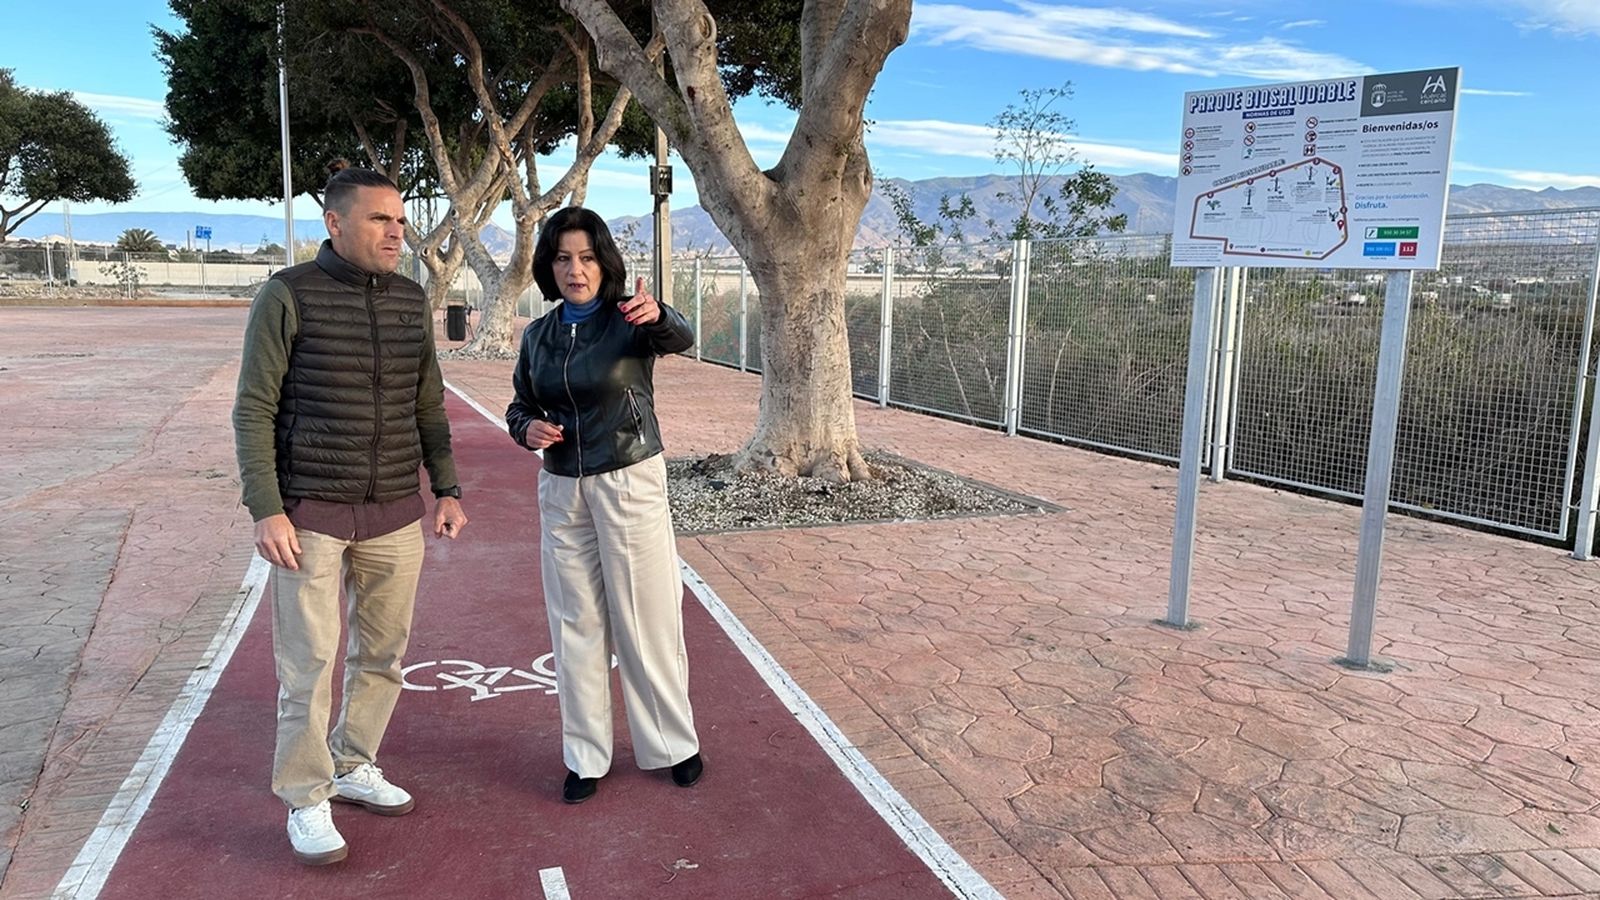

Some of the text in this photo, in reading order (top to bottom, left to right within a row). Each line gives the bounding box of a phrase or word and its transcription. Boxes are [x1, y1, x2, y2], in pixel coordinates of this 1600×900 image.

[1190, 81, 1356, 114] PARQUE BIOSALUDABLE
[1362, 120, 1439, 133] Bienvenidas/os
[1354, 201, 1388, 209] Disfruta.
